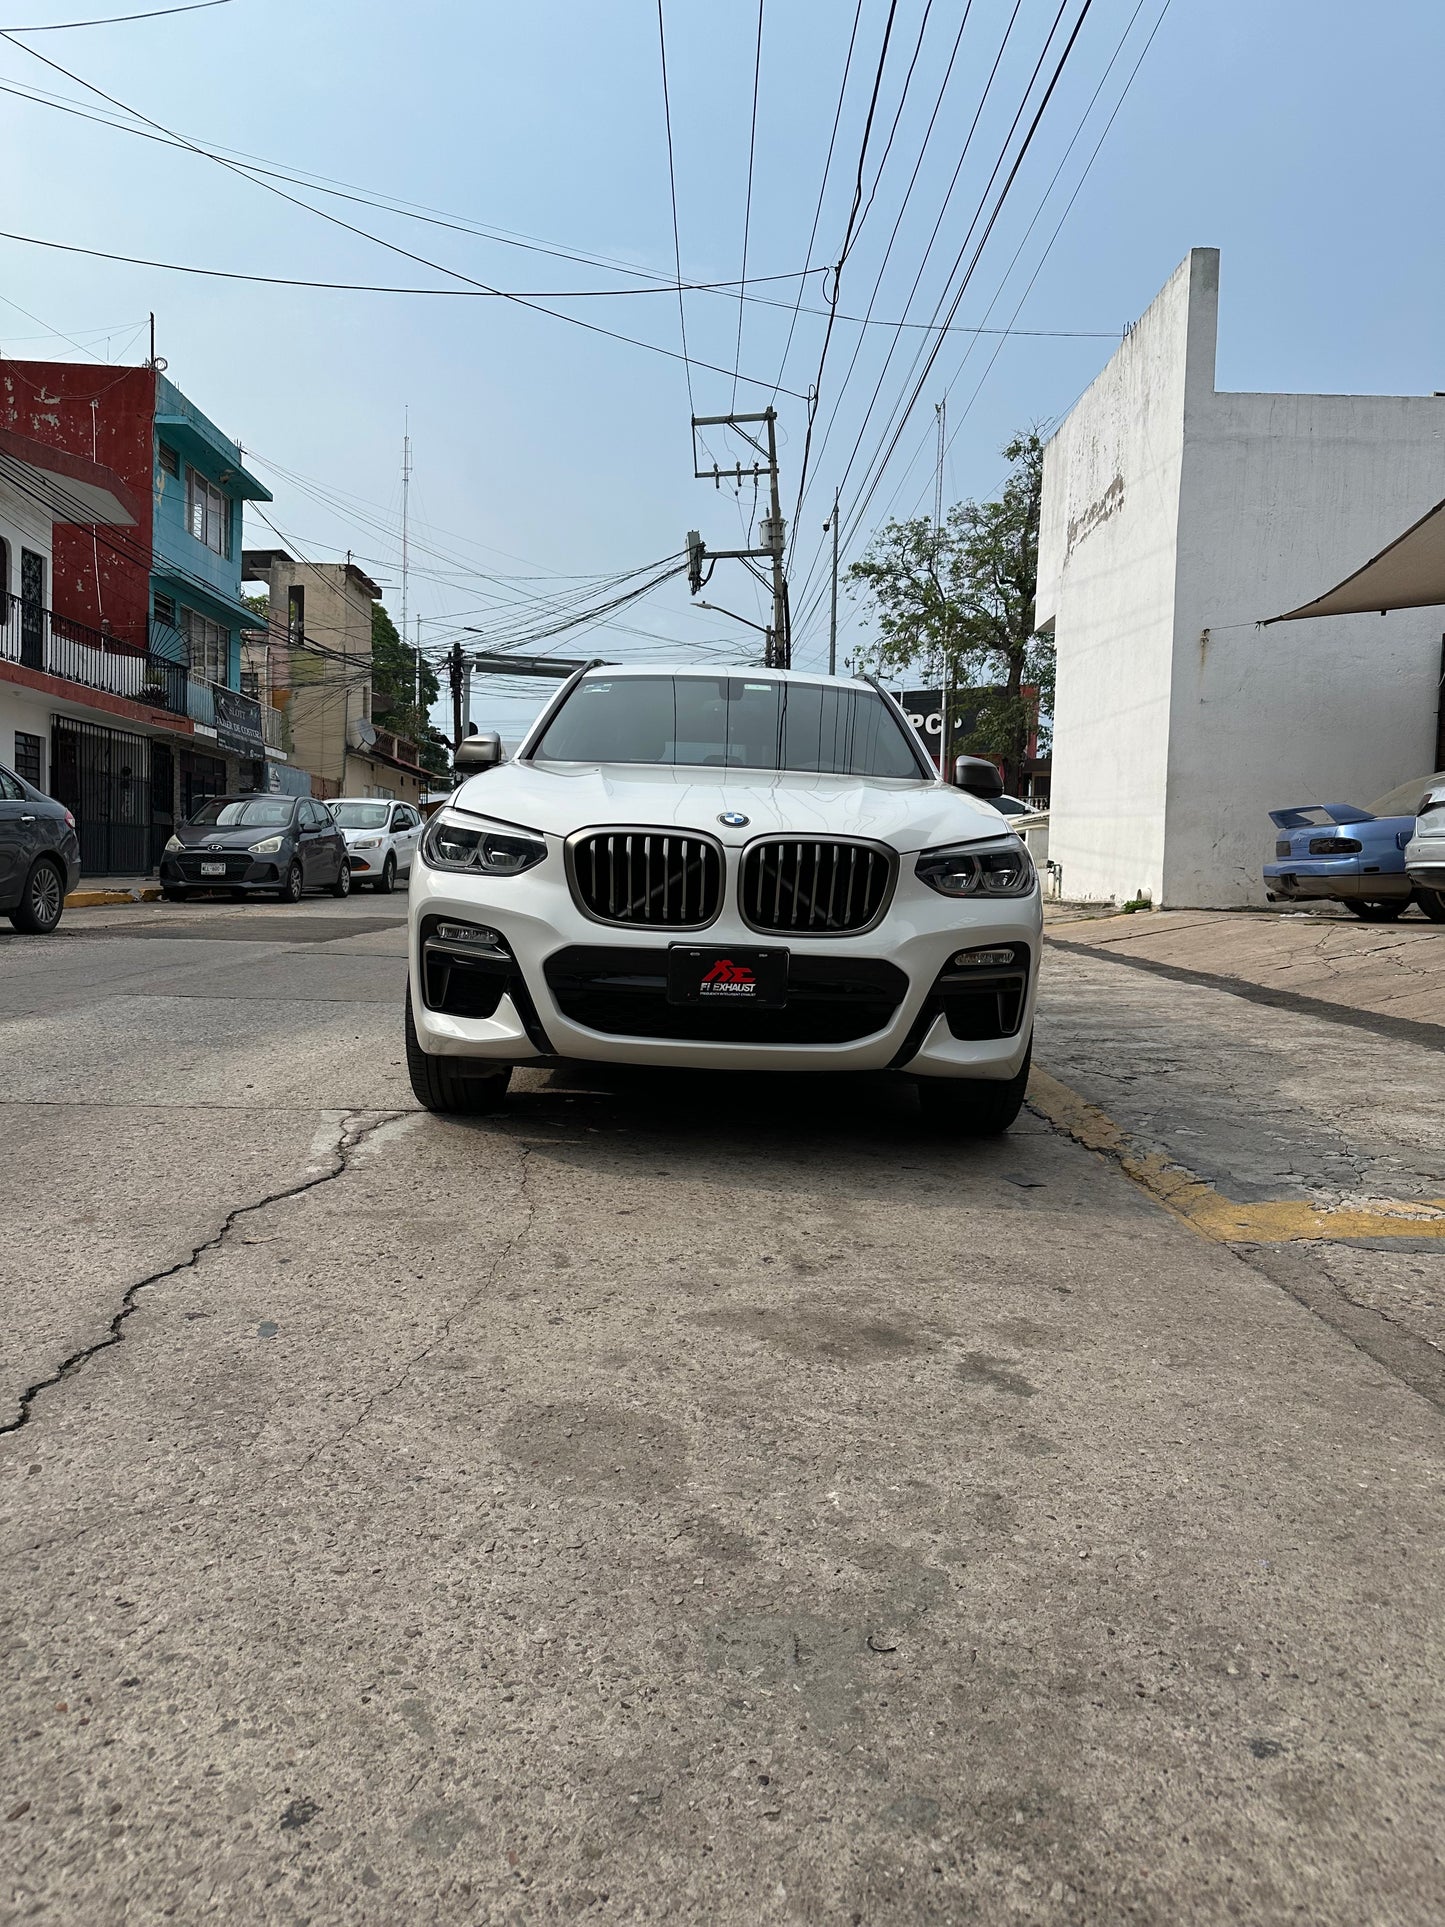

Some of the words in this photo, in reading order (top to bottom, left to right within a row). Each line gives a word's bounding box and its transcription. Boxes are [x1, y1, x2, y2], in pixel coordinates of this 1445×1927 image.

[215, 715, 233, 730] TALLER
[233, 723, 241, 733] DE
[713, 983, 756, 992] EXHAUST
